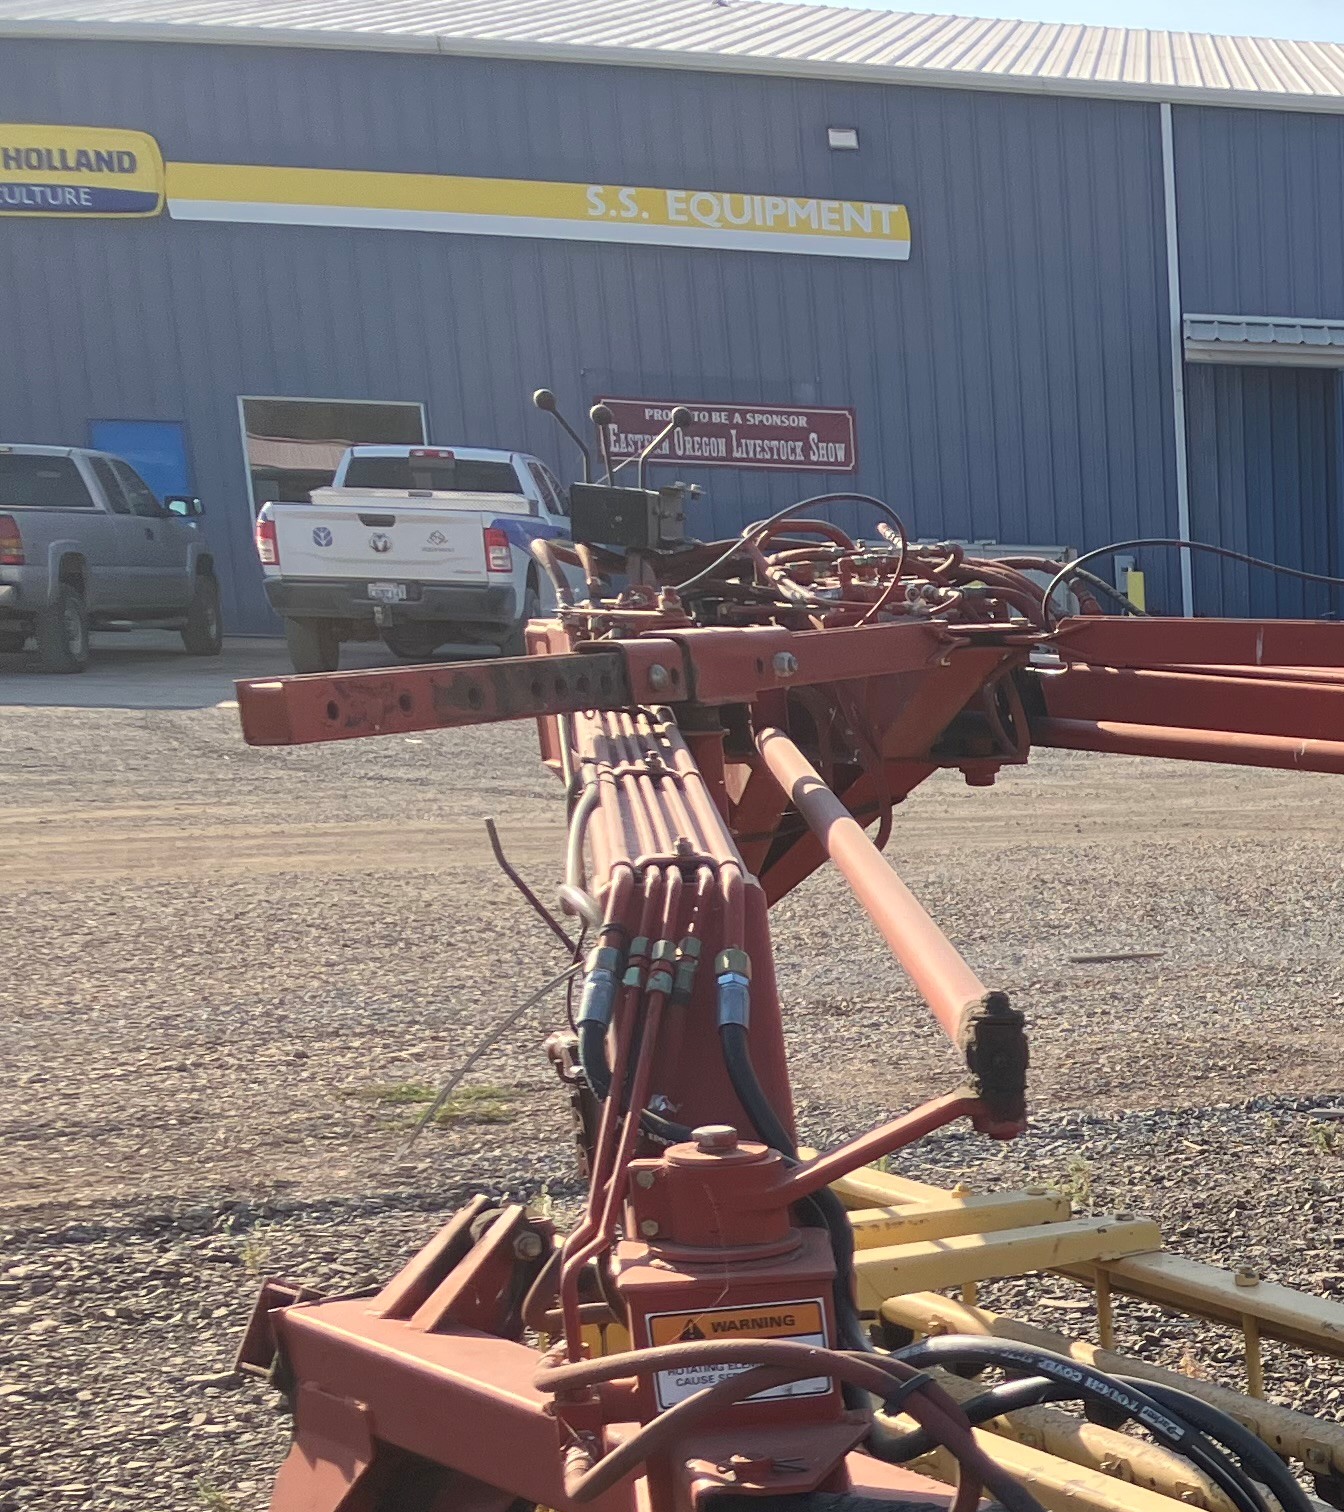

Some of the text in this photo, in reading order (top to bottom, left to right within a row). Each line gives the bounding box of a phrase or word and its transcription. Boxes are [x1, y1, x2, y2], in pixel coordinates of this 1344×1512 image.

[1, 147, 137, 174] HOLLAND
[0, 185, 93, 207] ULTURE
[586, 185, 898, 235] S.S. EQUIPMENT
[692, 411, 710, 422] TO
[712, 411, 730, 424] BE
[733, 412, 743, 424] A
[746, 412, 808, 428] SPONSOR
[711, 1314, 796, 1334] WARNING
[675, 1375, 715, 1387] CAUSE
[1084, 1377, 1138, 1413] TOUGH
